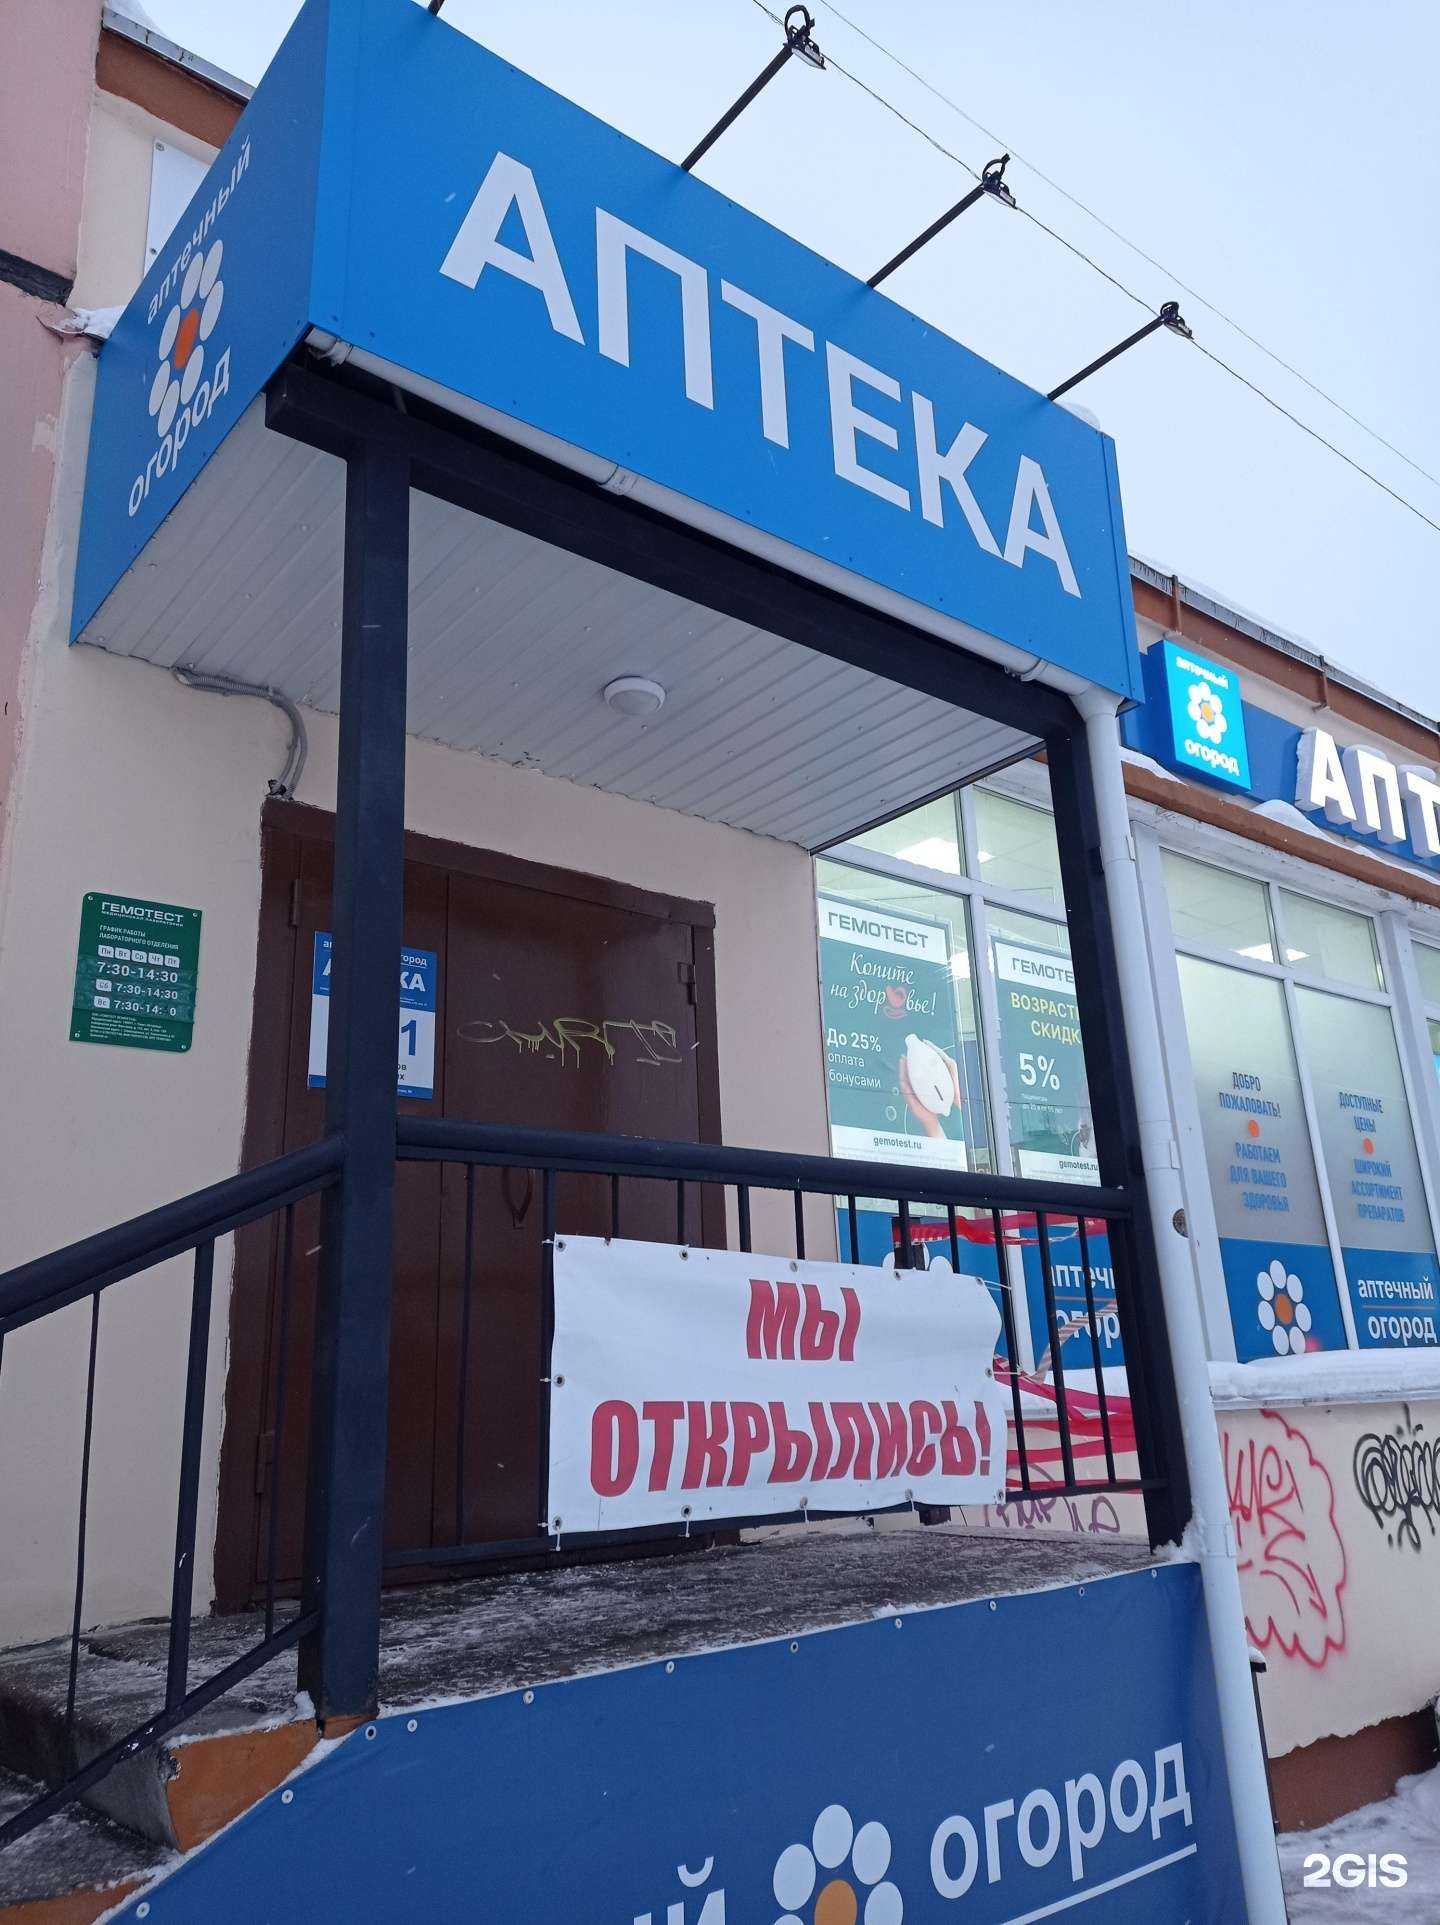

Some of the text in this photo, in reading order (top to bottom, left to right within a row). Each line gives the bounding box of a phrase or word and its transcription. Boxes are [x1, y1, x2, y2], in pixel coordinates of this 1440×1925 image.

[148, 134, 250, 324] аптечный
[439, 151, 1082, 599] АПТЕКА
[129, 345, 231, 517] огород
[1175, 656, 1229, 689] аптечный
[1184, 739, 1240, 776] огород
[101, 901, 184, 923] ГЕМОТЕСТ
[828, 912, 928, 949] ГЕМОТЕСТ
[97, 961, 178, 983] 7:30-14:30
[850, 951, 914, 985] Копите
[116, 983, 178, 1000] 7:30-14:30
[830, 985, 848, 998] на
[826, 1028, 882, 1052] До 25%
[827, 1053, 865, 1068] оплата
[1018, 1052, 1061, 1091] 5%
[828, 1070, 882, 1088] бонусами
[1232, 1071, 1261, 1092] ДОБРО
[1219, 1092, 1282, 1119] ПОЖАЛОВАТЬ!
[1339, 1091, 1384, 1114] ДОСТУПНЫЕ
[1354, 1117, 1376, 1134] ЦЕНЫ
[873, 1136, 922, 1150] gemotest.ru
[1235, 1142, 1281, 1163] РАБОТАЕМ
[1358, 1275, 1434, 1300] аптечный
[746, 1279, 861, 1362] МЫ
[1368, 1315, 1440, 1347] огород
[590, 1399, 992, 1497] ОТКРЫЛИСЬ!
[930, 1742, 1193, 1899] огород
